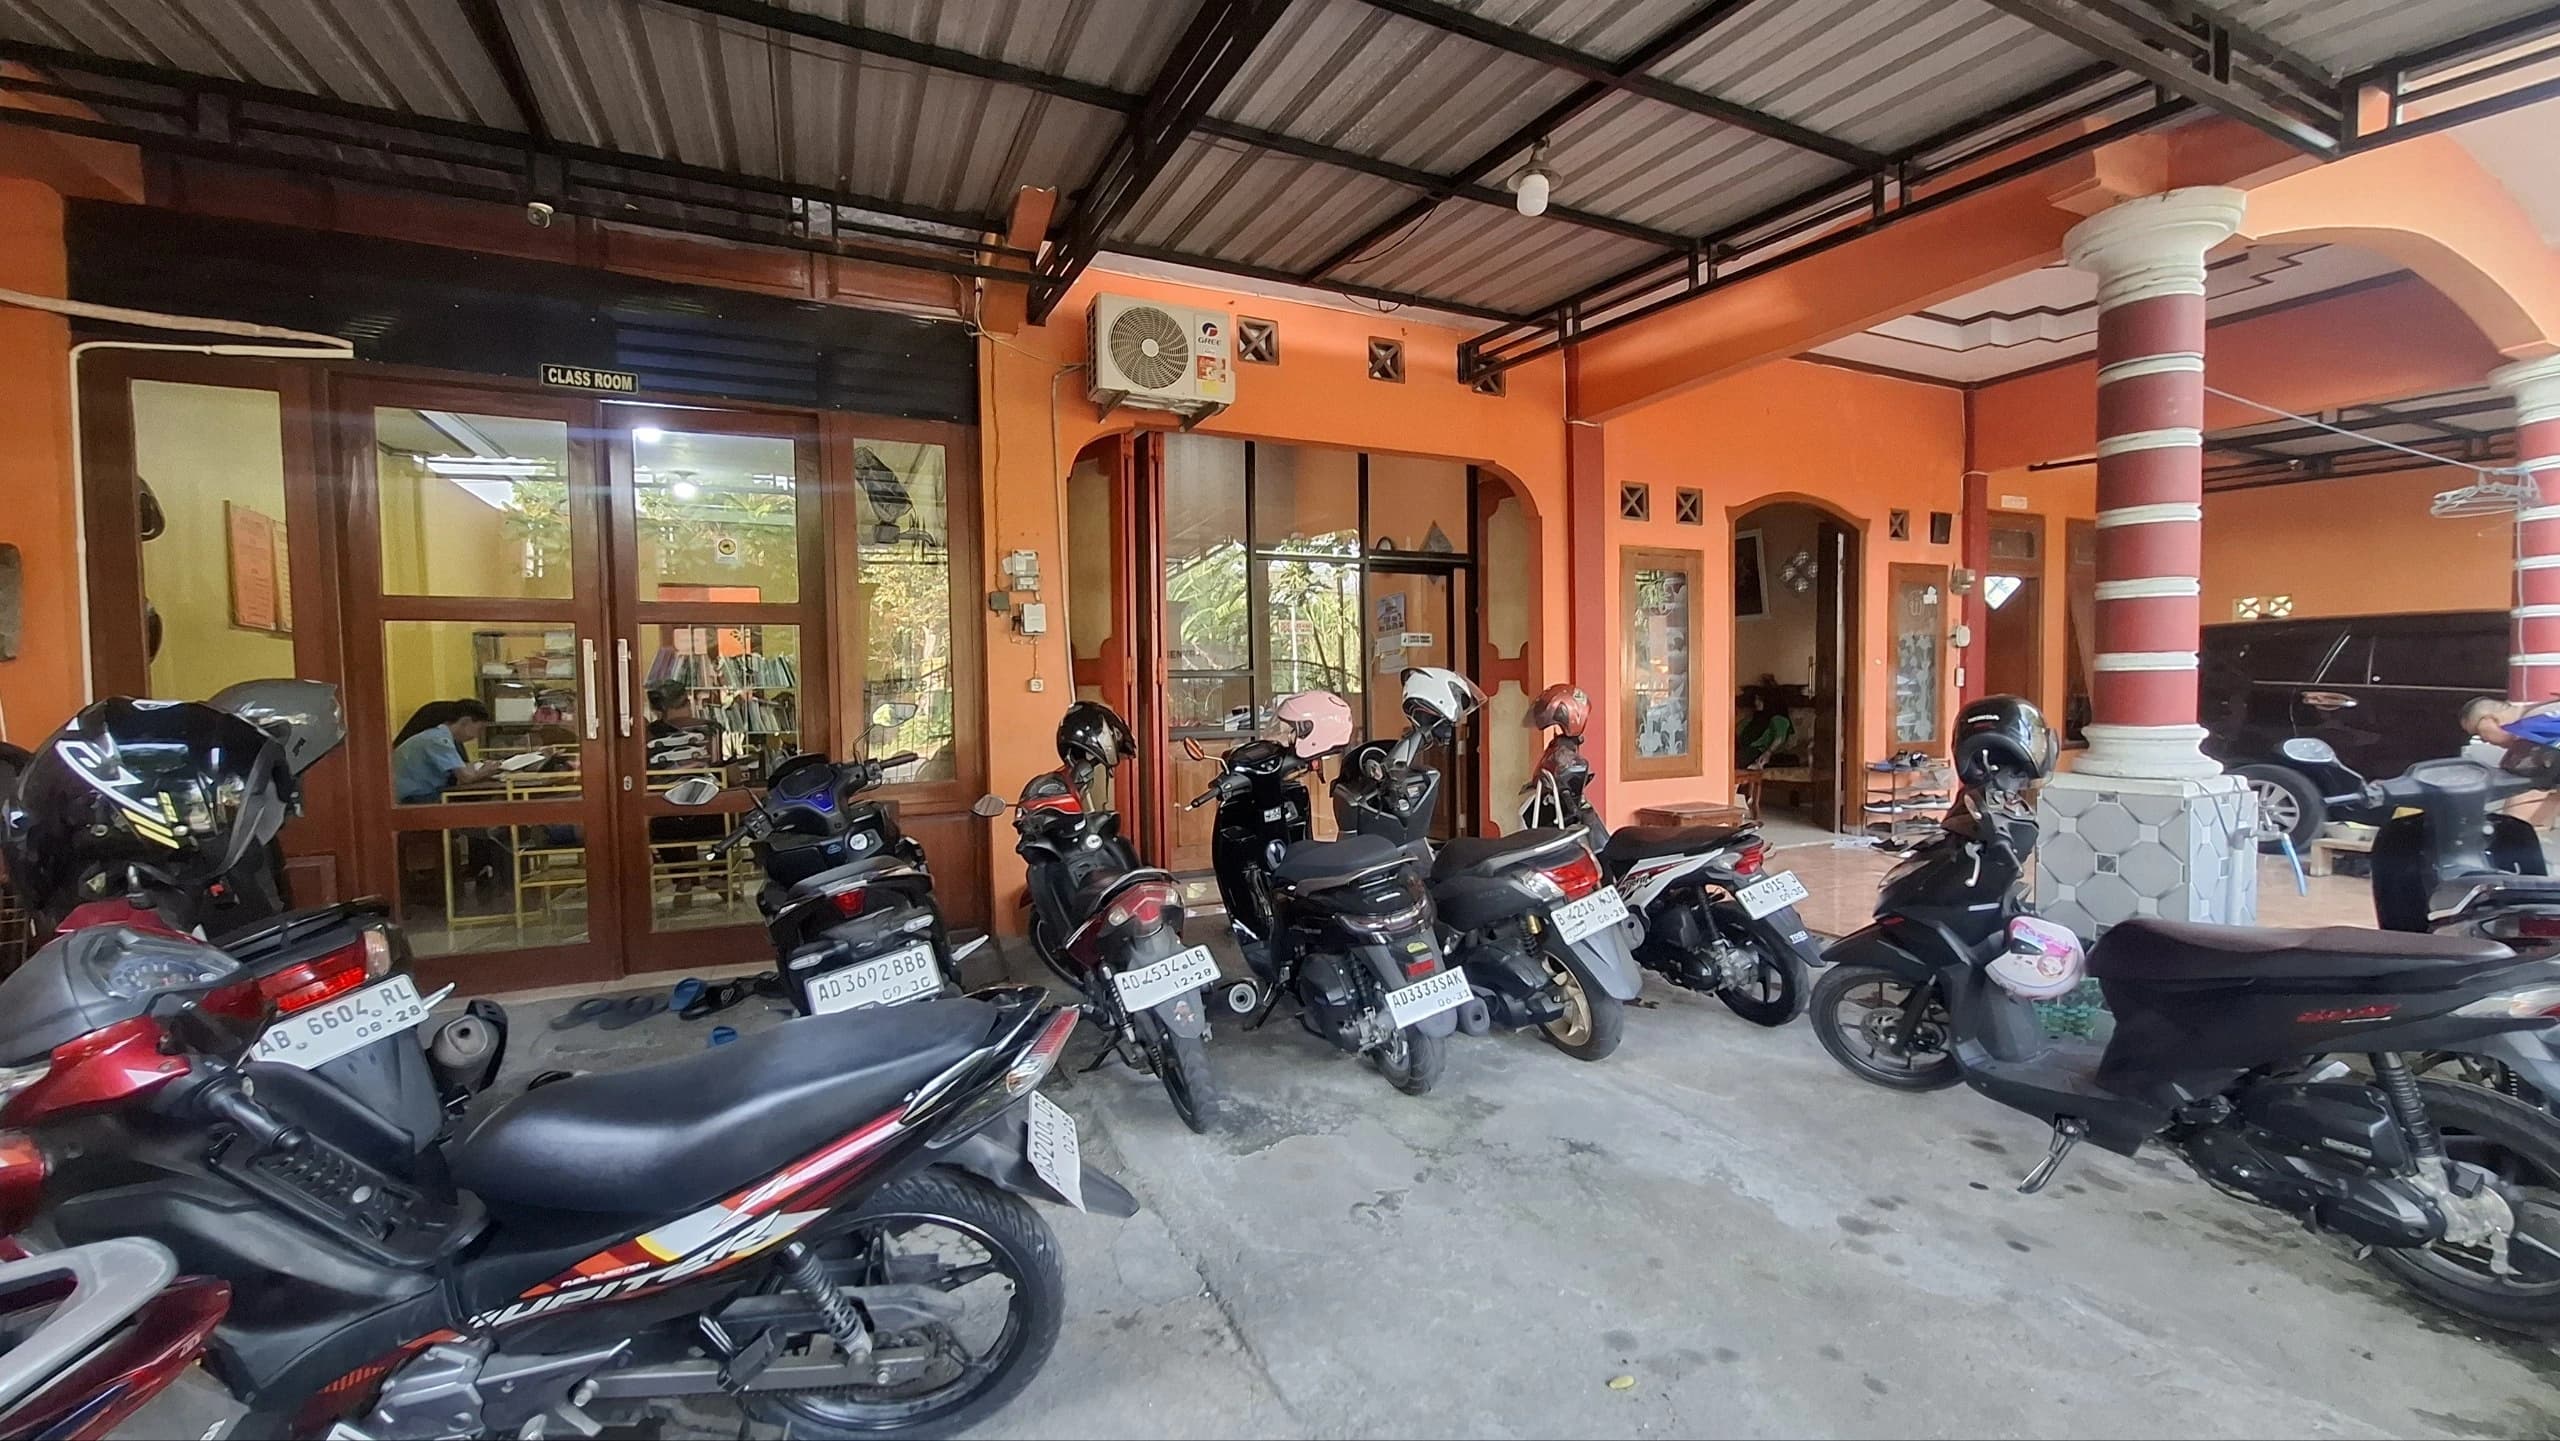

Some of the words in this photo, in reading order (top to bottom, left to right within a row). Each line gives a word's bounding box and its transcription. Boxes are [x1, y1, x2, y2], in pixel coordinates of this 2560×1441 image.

[548, 367, 591, 387] CLASS
[594, 372, 633, 391] ROOM
[892, 951, 927, 976] BBB
[1142, 960, 1179, 985] 4534
[259, 1030, 292, 1057] AB
[306, 998, 369, 1036] 6604
[379, 983, 412, 1006] RL
